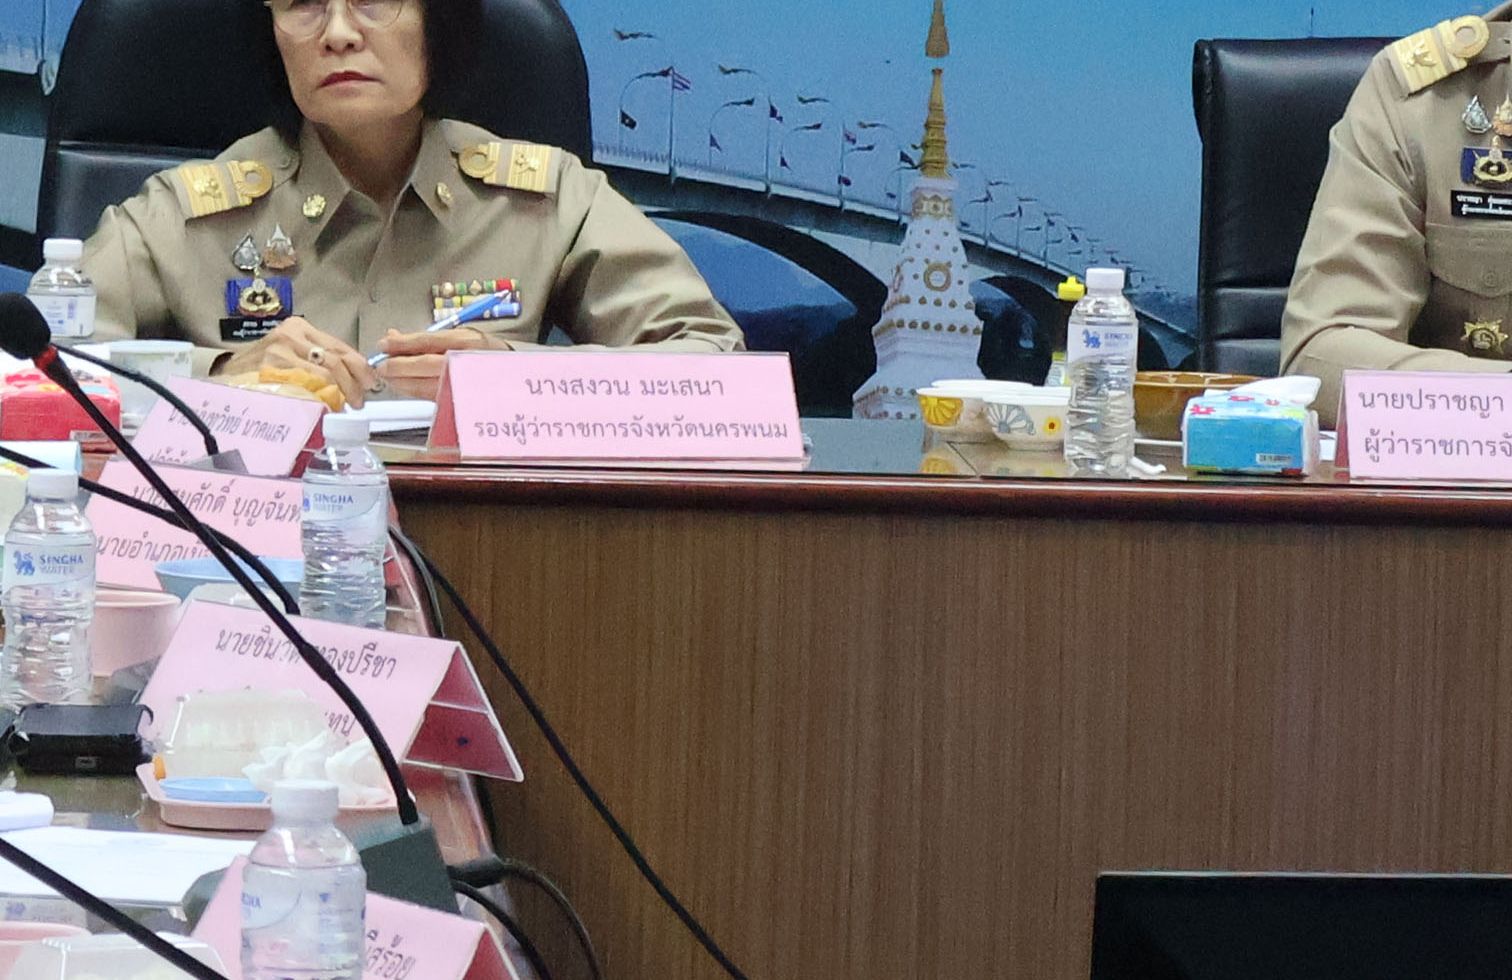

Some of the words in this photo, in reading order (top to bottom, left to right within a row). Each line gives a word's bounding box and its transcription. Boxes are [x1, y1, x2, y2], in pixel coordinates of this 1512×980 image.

[525, 376, 631, 396] นางสงวน
[640, 377, 724, 397] มะเสนา
[1358, 388, 1505, 419] นายปราชญา
[473, 414, 788, 446] รองผู้ว่าราชการจังหวัดนครพนม
[313, 493, 354, 504] SINGHA
[39, 554, 85, 565] SINGHA
